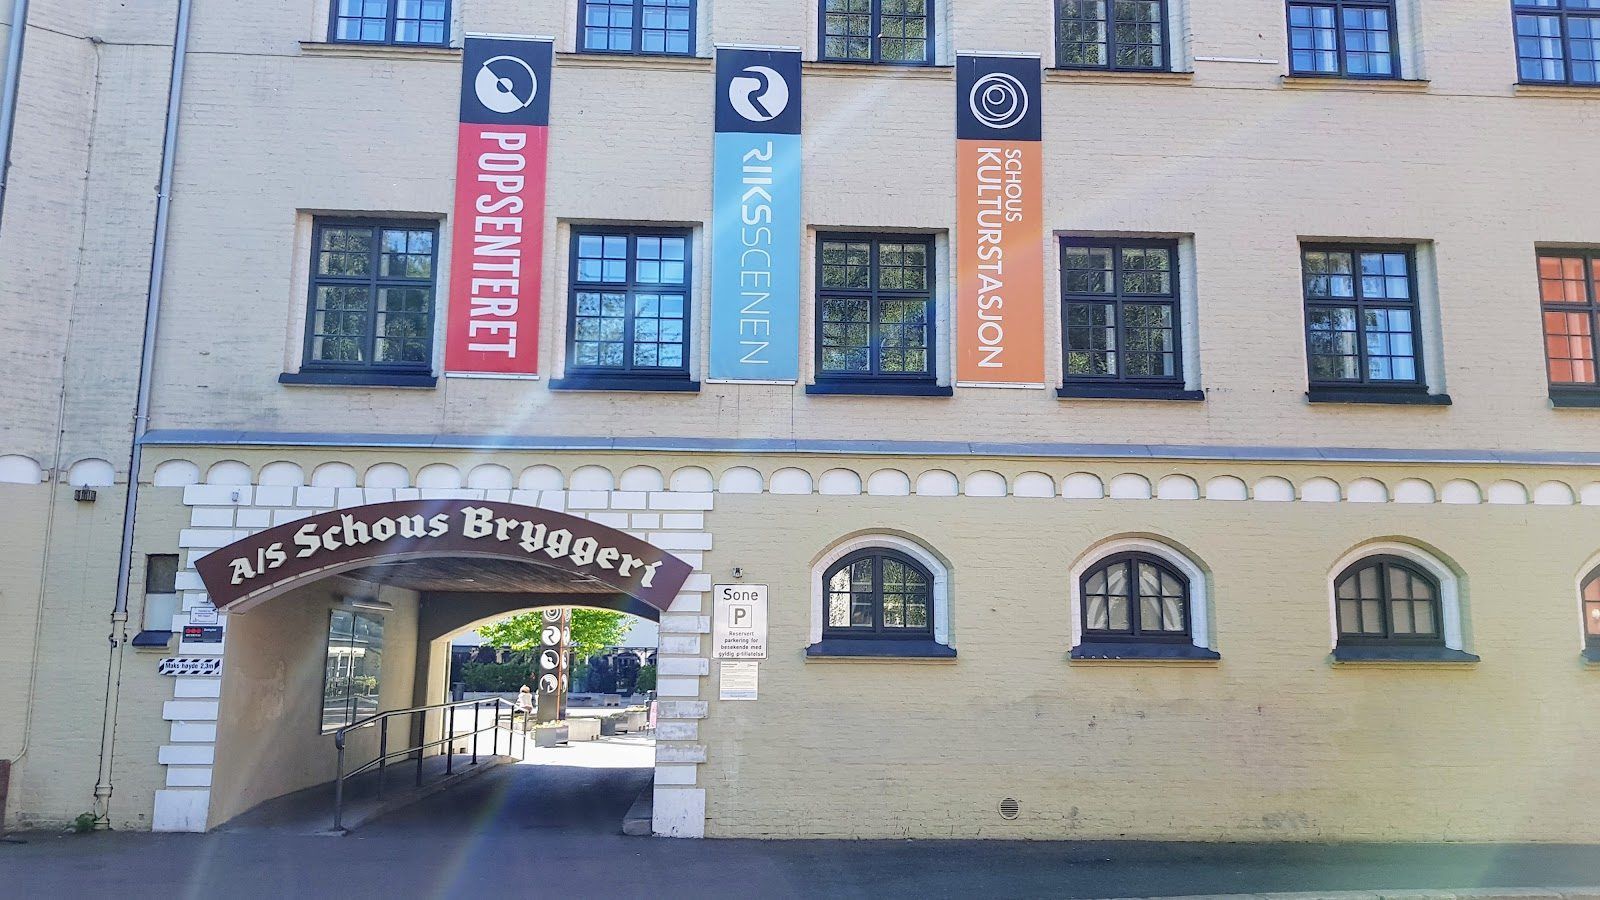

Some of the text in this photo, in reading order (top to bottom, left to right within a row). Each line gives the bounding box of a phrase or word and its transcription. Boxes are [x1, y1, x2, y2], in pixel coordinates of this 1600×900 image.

[1005, 149, 1022, 222] SCHOUS
[468, 131, 527, 358] POPSENTERET
[739, 141, 773, 364] RIKSSCENEN
[976, 147, 1003, 368] KULTURSTASJON
[228, 506, 663, 588] A/S Schous Bryggeri
[723, 588, 758, 600] Sone
[734, 608, 746, 624] P
[724, 637, 749, 645] parkering
